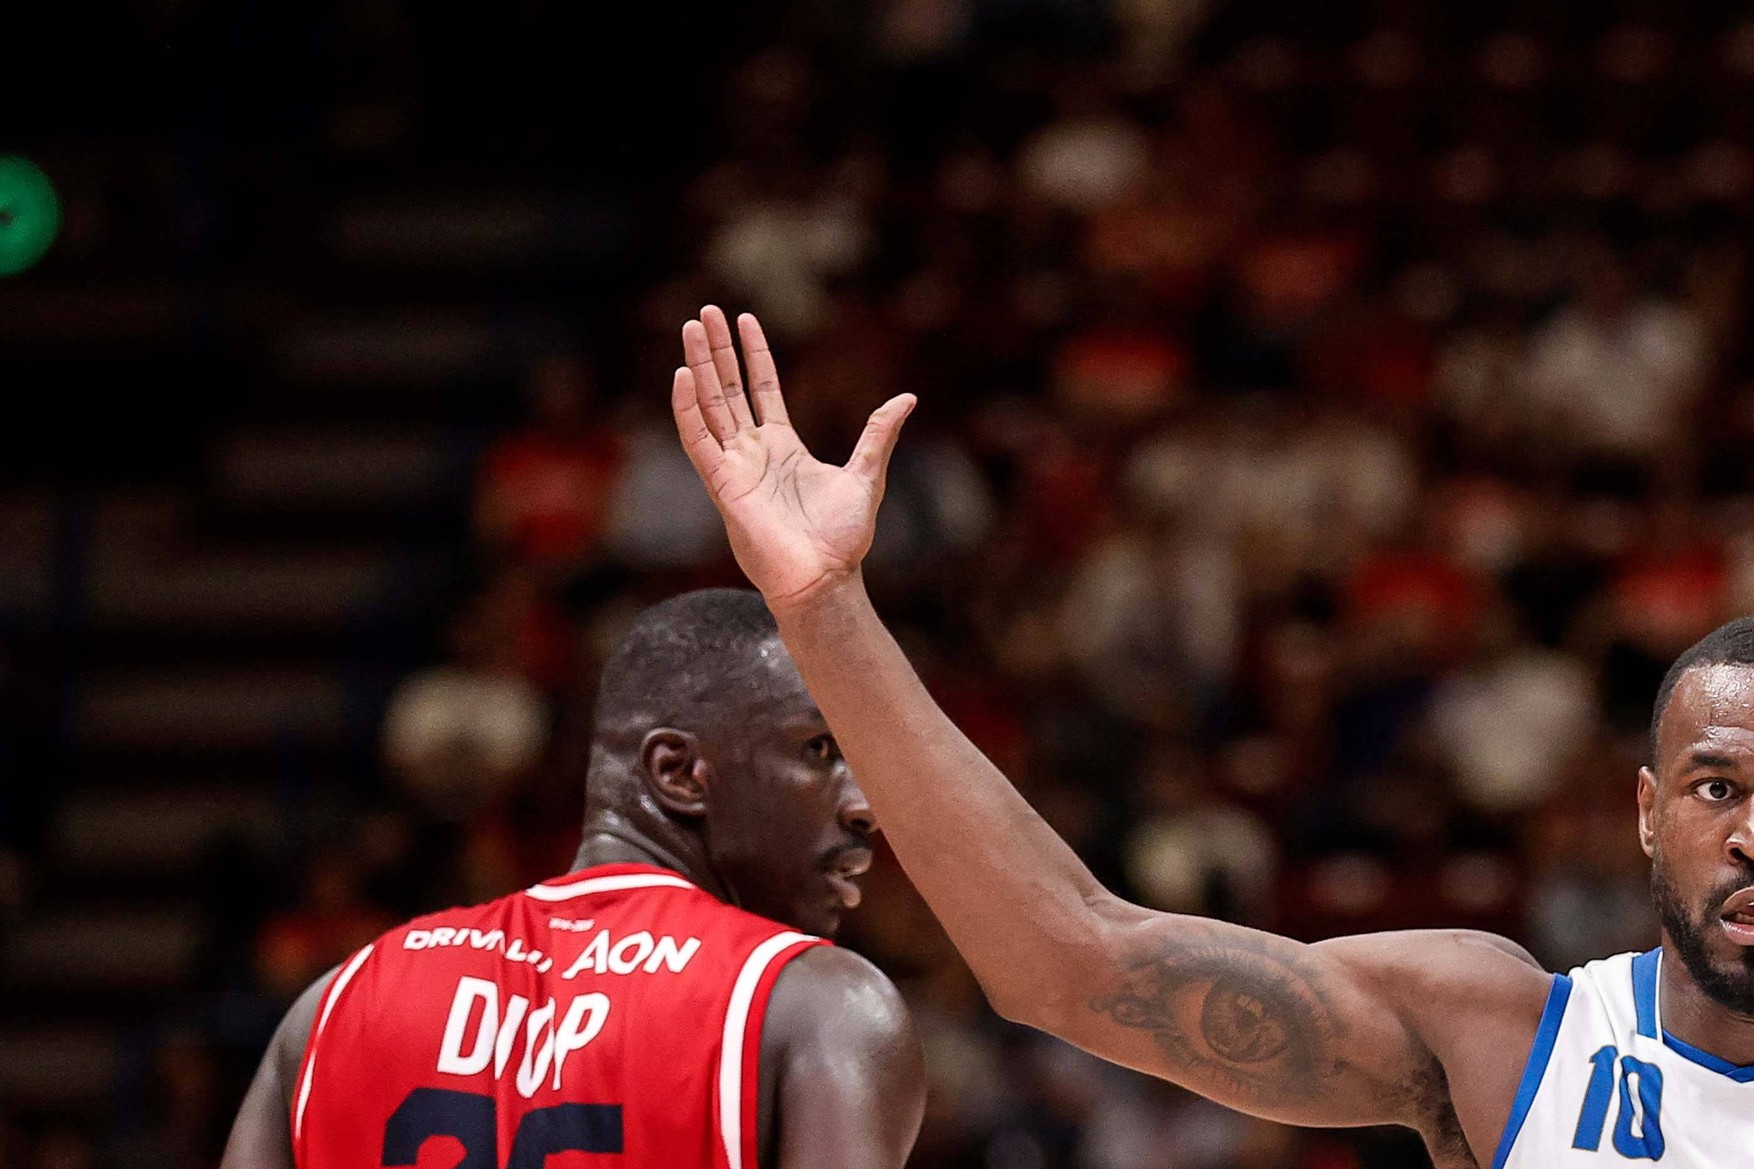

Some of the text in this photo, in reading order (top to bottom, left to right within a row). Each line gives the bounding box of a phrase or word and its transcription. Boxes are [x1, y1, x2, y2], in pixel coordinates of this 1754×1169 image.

[561, 929, 702, 980] AON
[436, 976, 610, 1098] DIOP
[1572, 1045, 1666, 1161] 10
